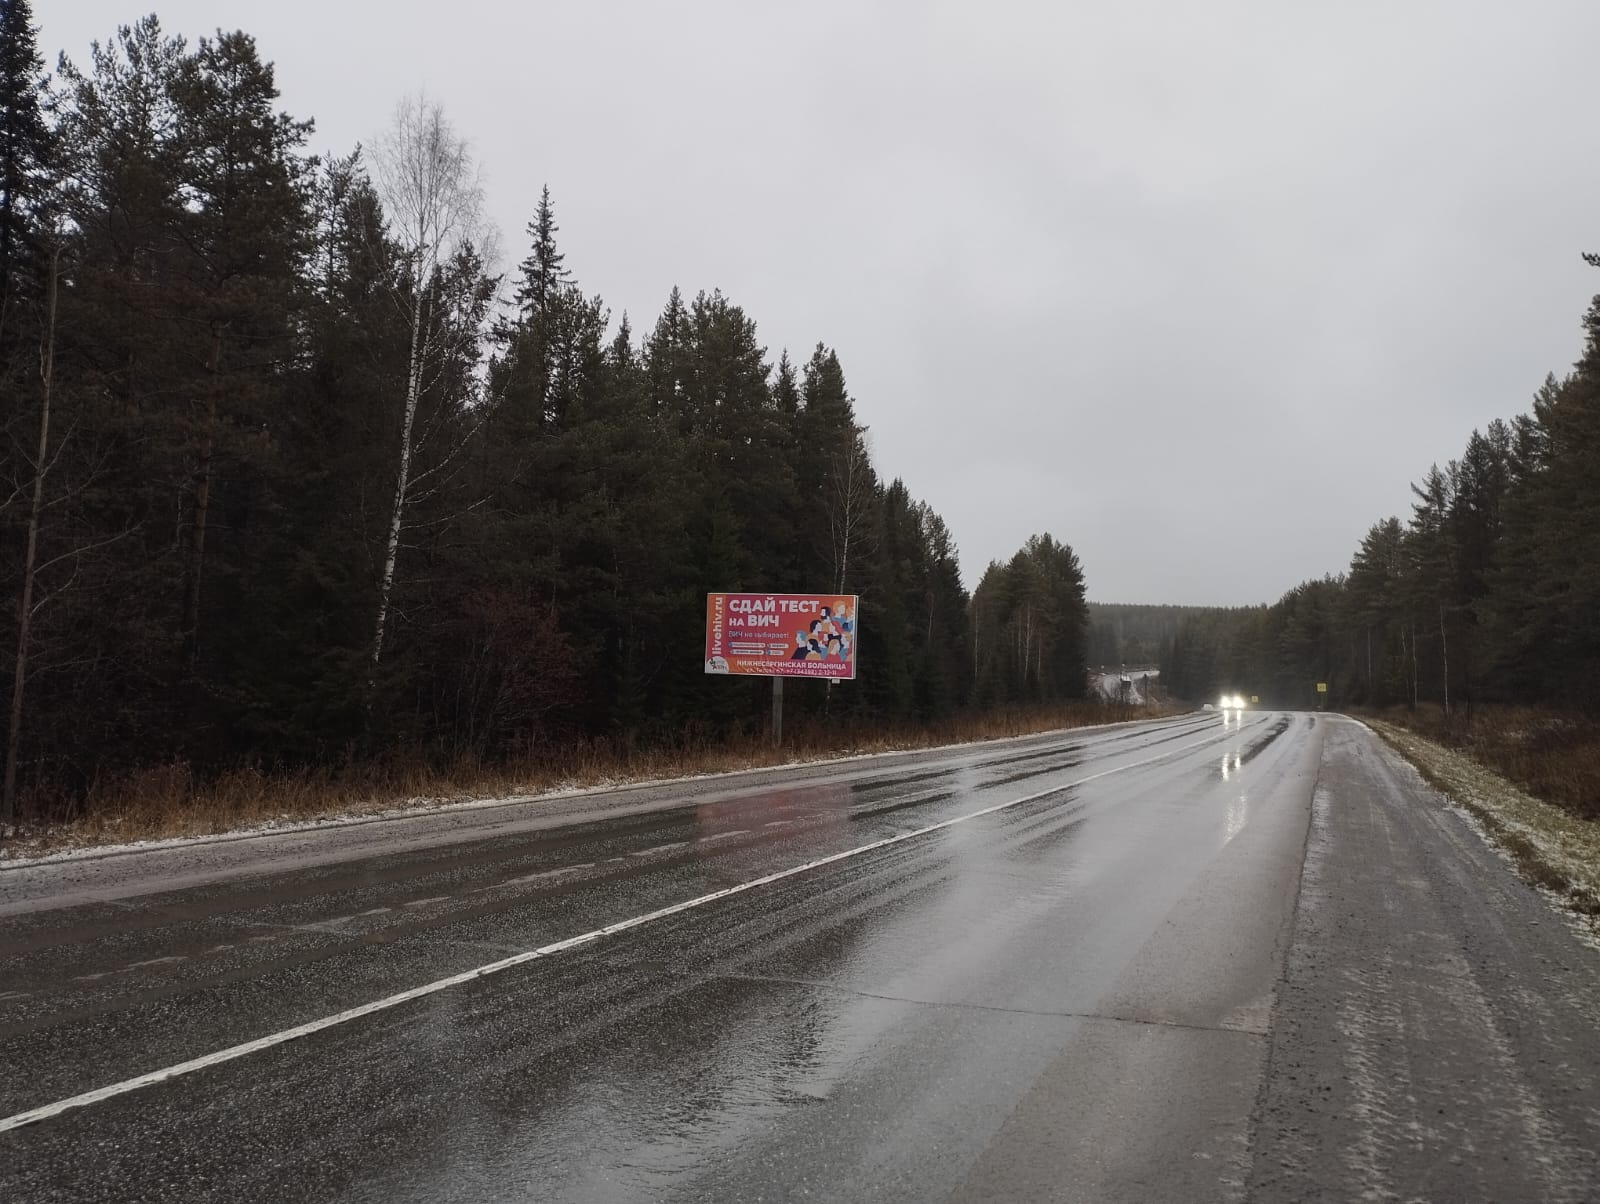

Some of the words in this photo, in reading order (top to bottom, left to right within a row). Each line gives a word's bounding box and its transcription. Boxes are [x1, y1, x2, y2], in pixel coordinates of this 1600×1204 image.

[729, 597, 776, 614] СДАЙ
[779, 600, 820, 613] ТЕСТ
[711, 597, 723, 655] livehiv.ru
[747, 614, 780, 627] ВИЧ
[736, 660, 806, 669] НИЖНЕСЕРГИНСКАЯ
[807, 662, 847, 670] БОЛЬНИЦА
